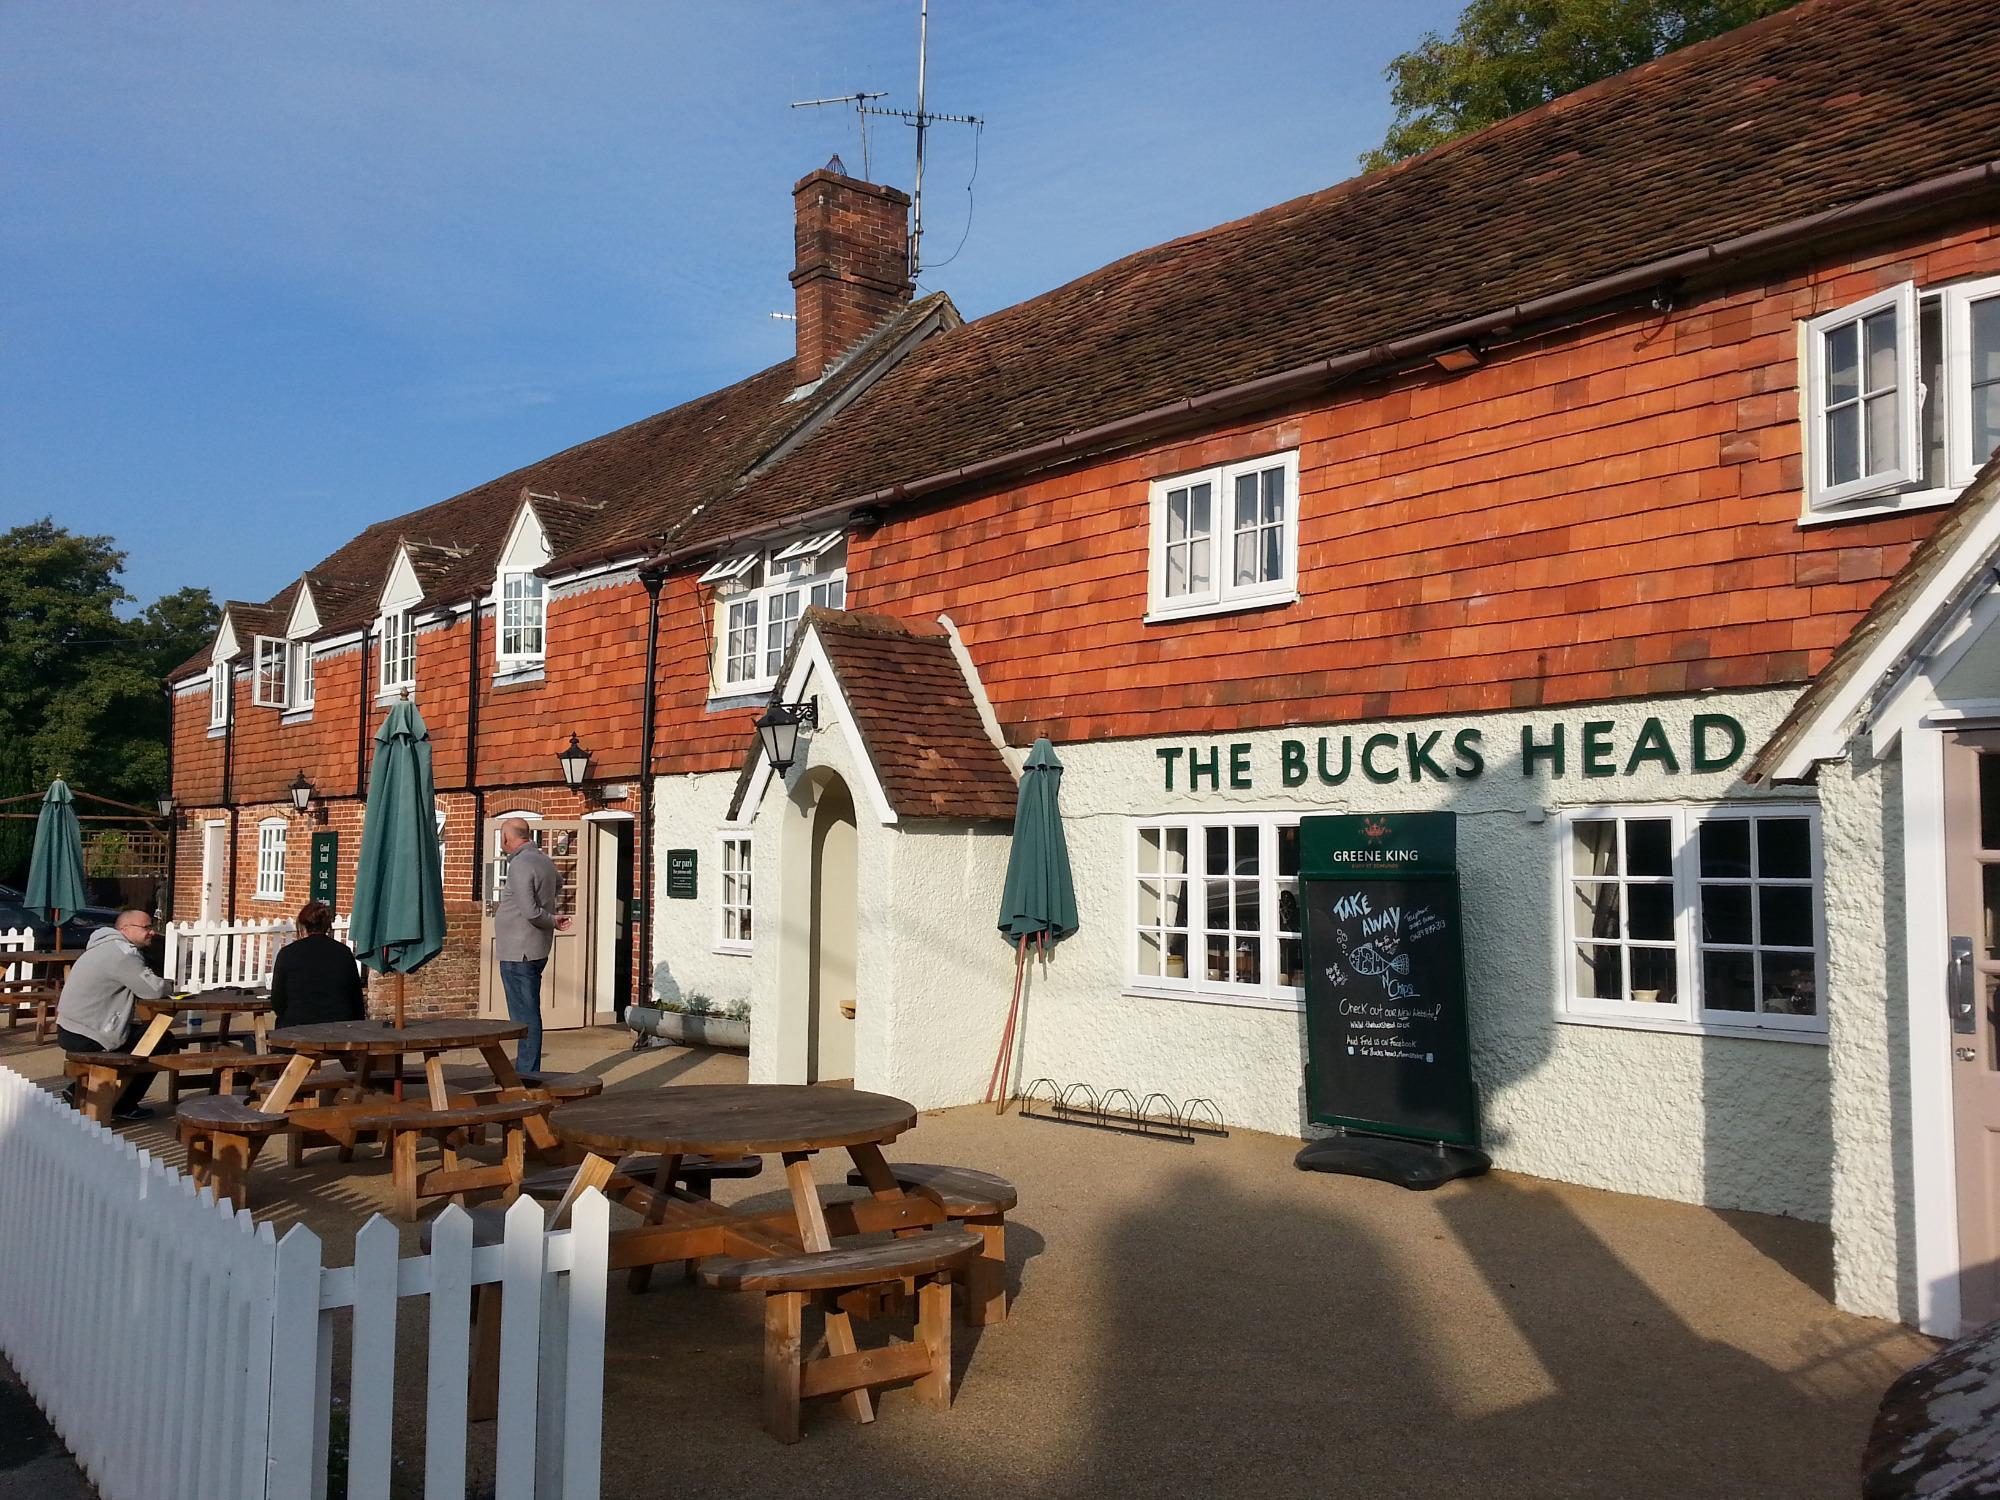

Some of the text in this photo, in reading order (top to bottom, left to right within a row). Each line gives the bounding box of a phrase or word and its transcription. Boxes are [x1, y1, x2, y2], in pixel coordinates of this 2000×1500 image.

[1156, 714, 1747, 792] THE BUCKS HEAD
[672, 858, 692, 870] Car park
[1333, 849, 1419, 862] GREENE KING
[1333, 891, 1373, 922] TAKE
[1362, 907, 1400, 937] AWAY
[1388, 979, 1414, 998] Chips
